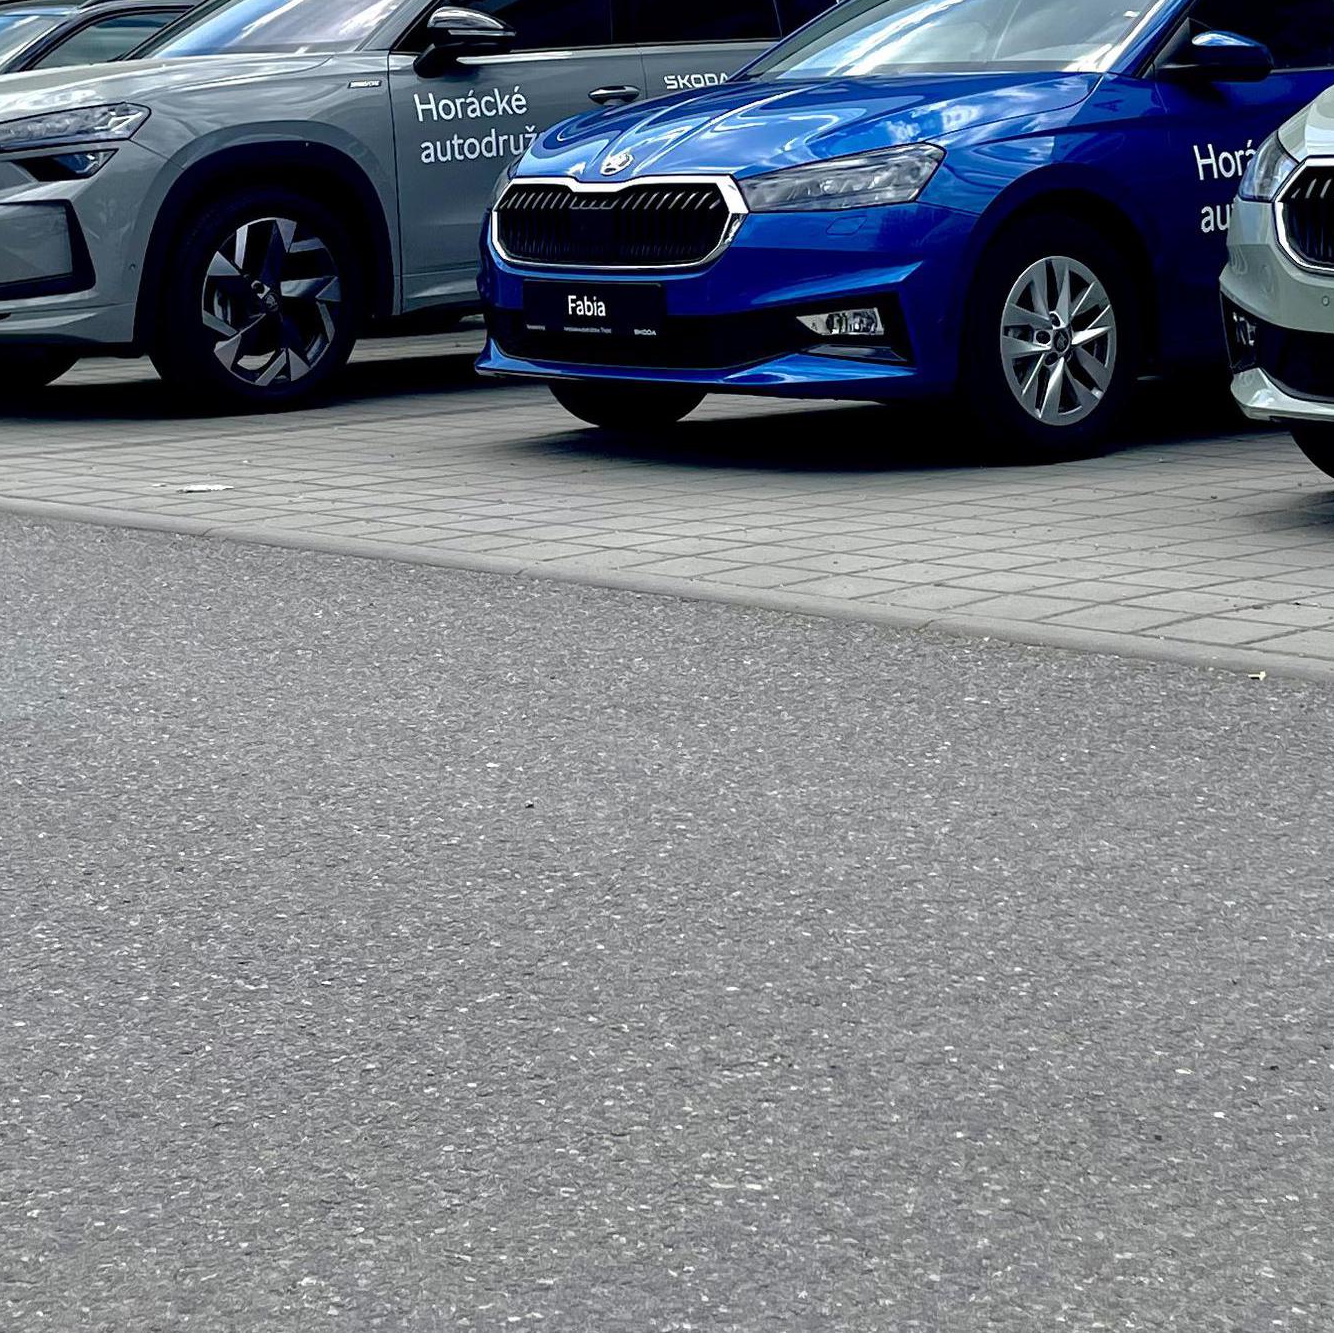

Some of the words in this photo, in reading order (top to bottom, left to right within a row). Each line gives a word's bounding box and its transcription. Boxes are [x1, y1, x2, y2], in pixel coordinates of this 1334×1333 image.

[414, 85, 527, 122] Horácké
[420, 125, 539, 164] autodruž
[1201, 203, 1233, 233] au
[567, 295, 606, 316] Fabia
